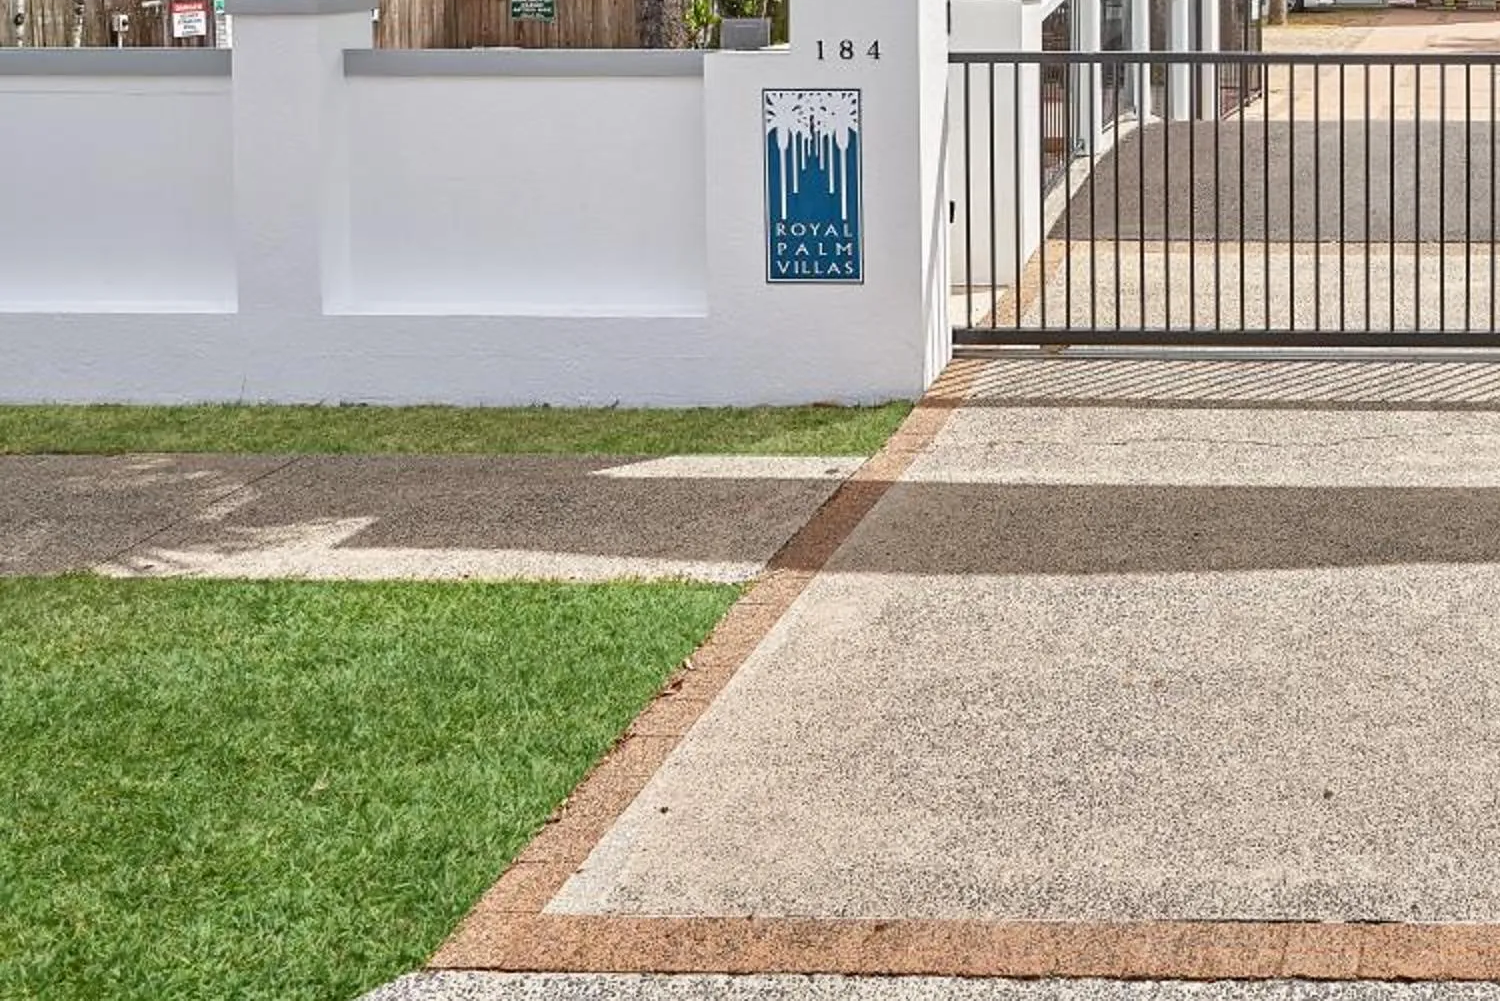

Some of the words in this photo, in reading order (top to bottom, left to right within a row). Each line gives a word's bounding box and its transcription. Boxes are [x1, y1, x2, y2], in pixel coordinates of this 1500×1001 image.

[815, 39, 882, 61] 184
[775, 222, 853, 237] ROYAL
[776, 242, 854, 256] PALM
[776, 261, 854, 275] VILLAS
